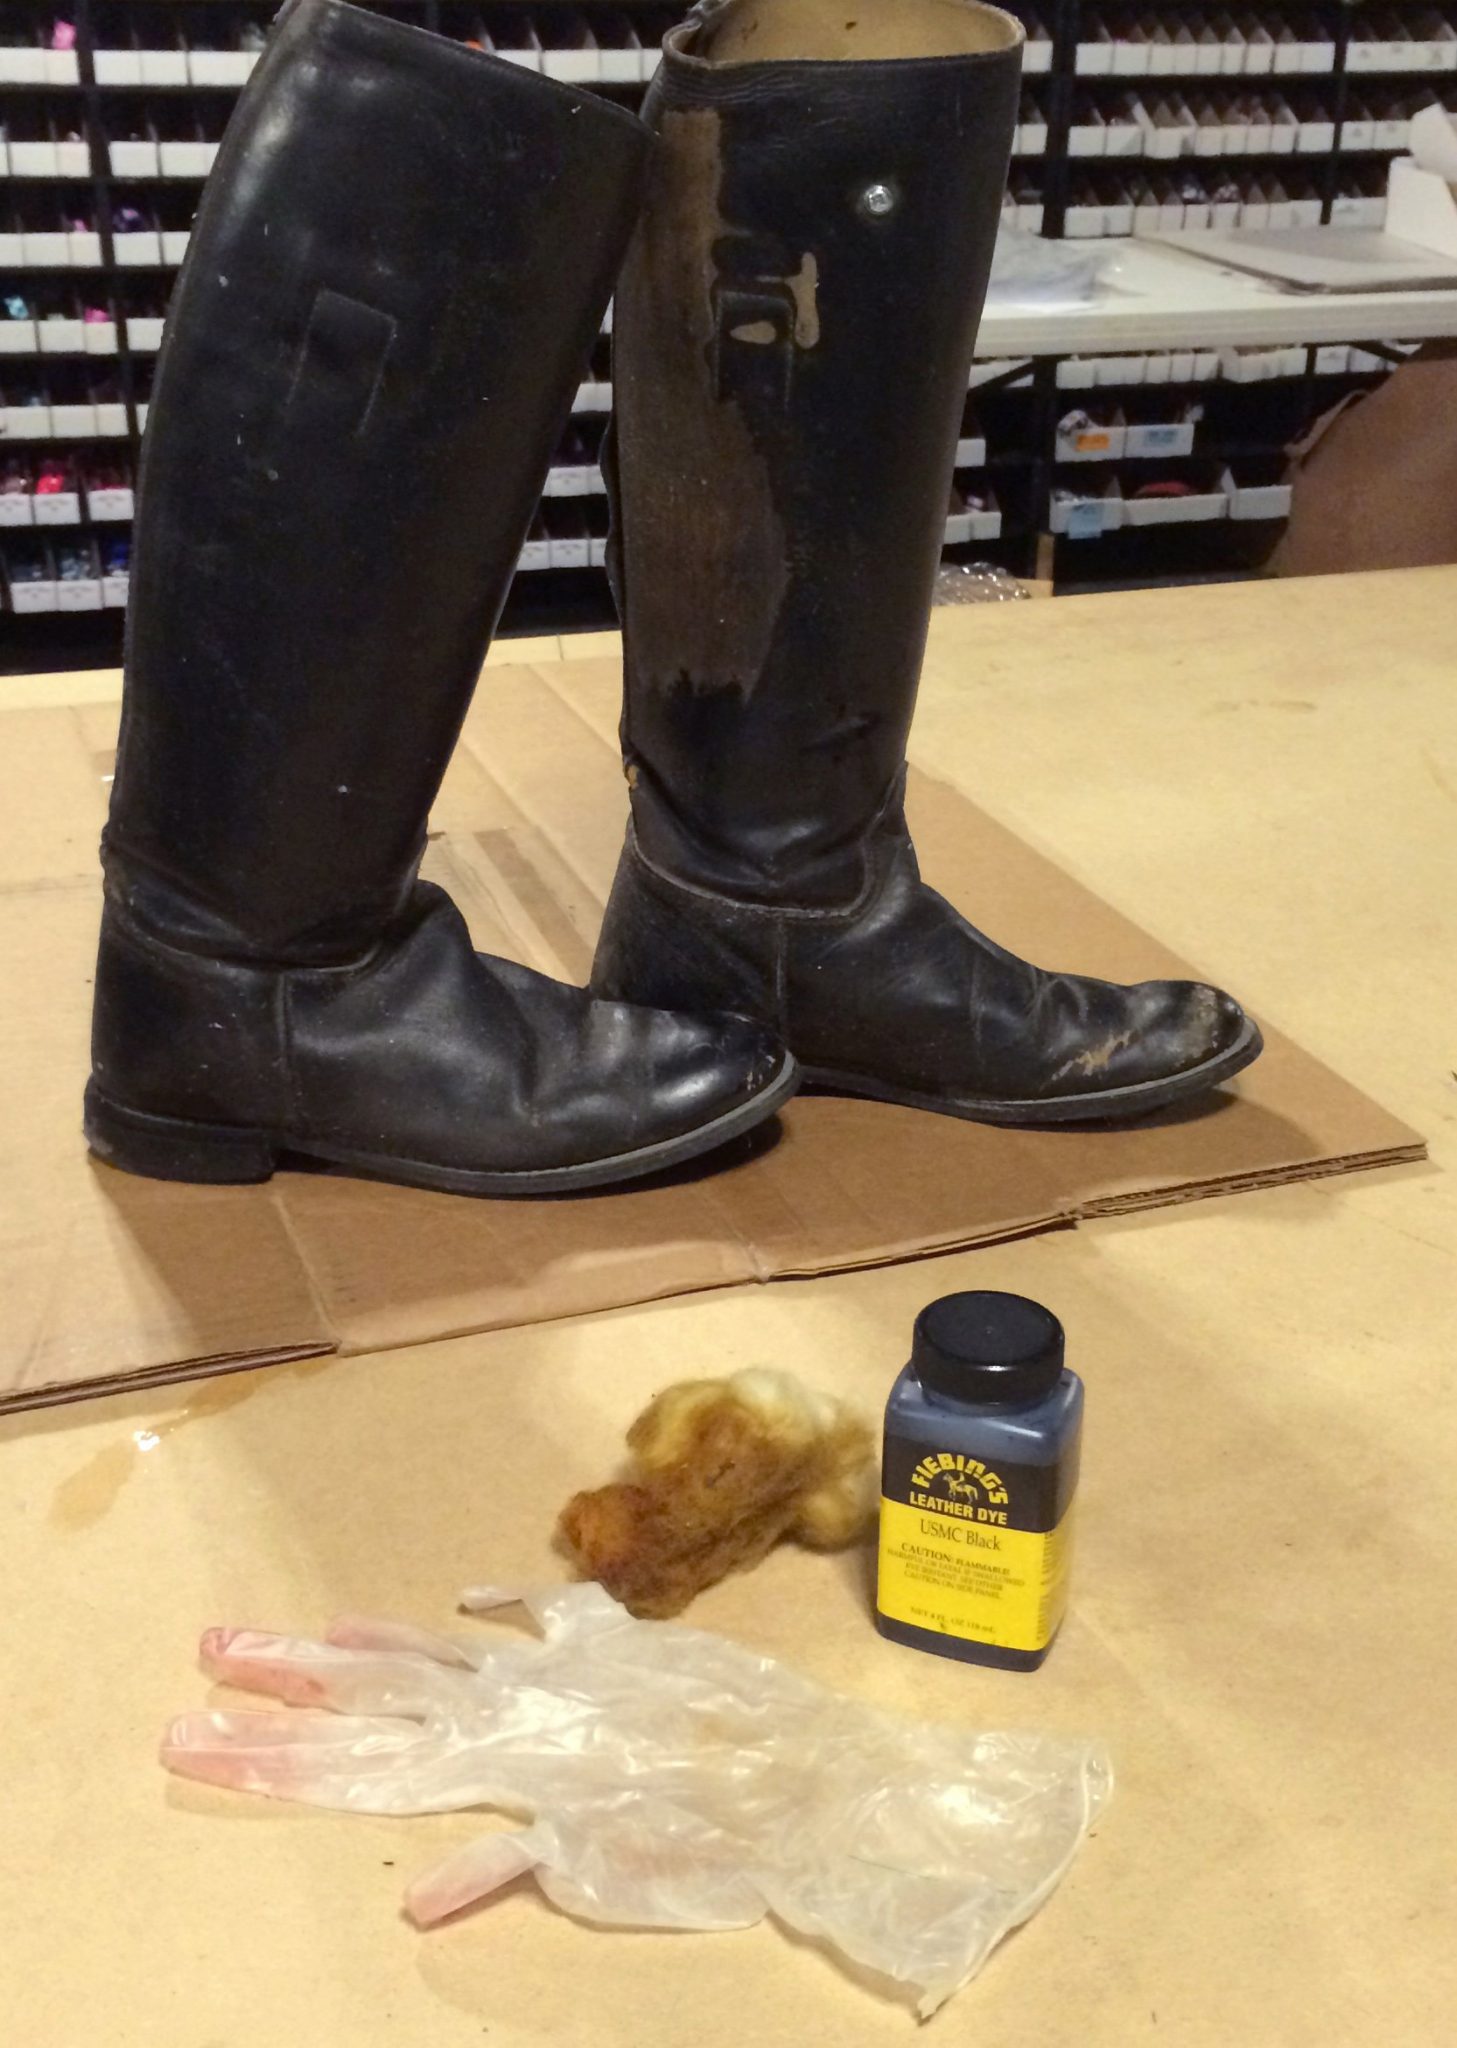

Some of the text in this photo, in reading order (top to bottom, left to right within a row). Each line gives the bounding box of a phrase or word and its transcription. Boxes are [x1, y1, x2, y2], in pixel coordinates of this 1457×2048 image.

[909, 1491, 1008, 1526] LEATHER DYE
[920, 1518, 1002, 1551] USMC Black
[901, 1542, 952, 1562] CAUTION:
